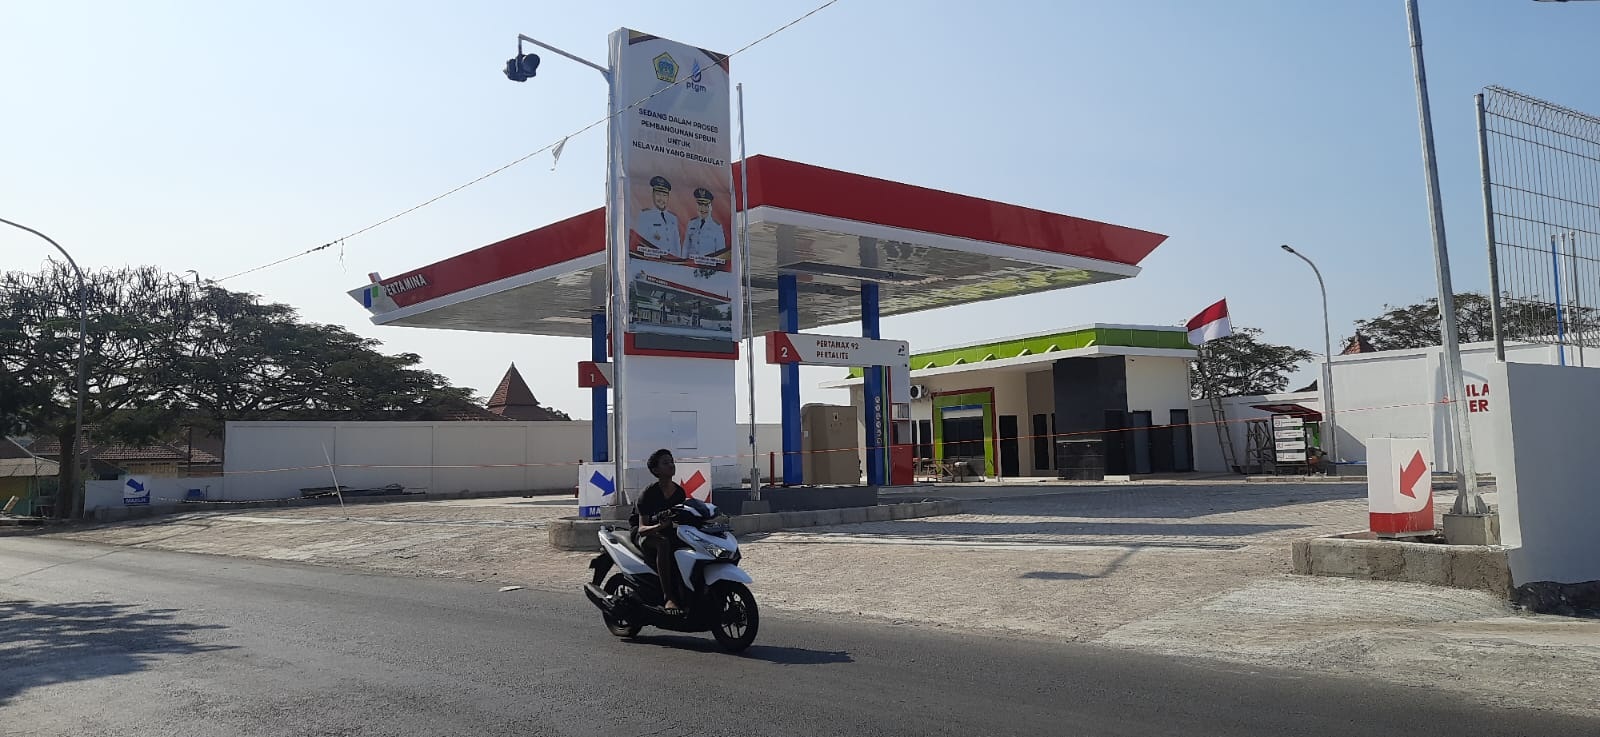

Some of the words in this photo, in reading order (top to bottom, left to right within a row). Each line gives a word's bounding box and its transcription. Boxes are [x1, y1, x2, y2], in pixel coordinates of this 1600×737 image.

[686, 82, 707, 93] ptgm
[638, 108, 667, 121] SEDANG
[668, 116, 691, 126] DALAM
[693, 121, 719, 133] PROSES
[641, 120, 694, 138] PEMBANGUNAN
[694, 134, 717, 143] SPBUN
[667, 137, 691, 148] UNTUK
[632, 140, 665, 153] NELAYAN
[666, 149, 685, 158] YANG
[686, 153, 724, 166] BERDAULAT
[383, 274, 427, 296] PERTAMINA
[816, 340, 850, 349] PERTAMAX
[781, 346, 788, 358] 2
[816, 351, 849, 360] PERTALITE
[590, 373, 595, 383] 1
